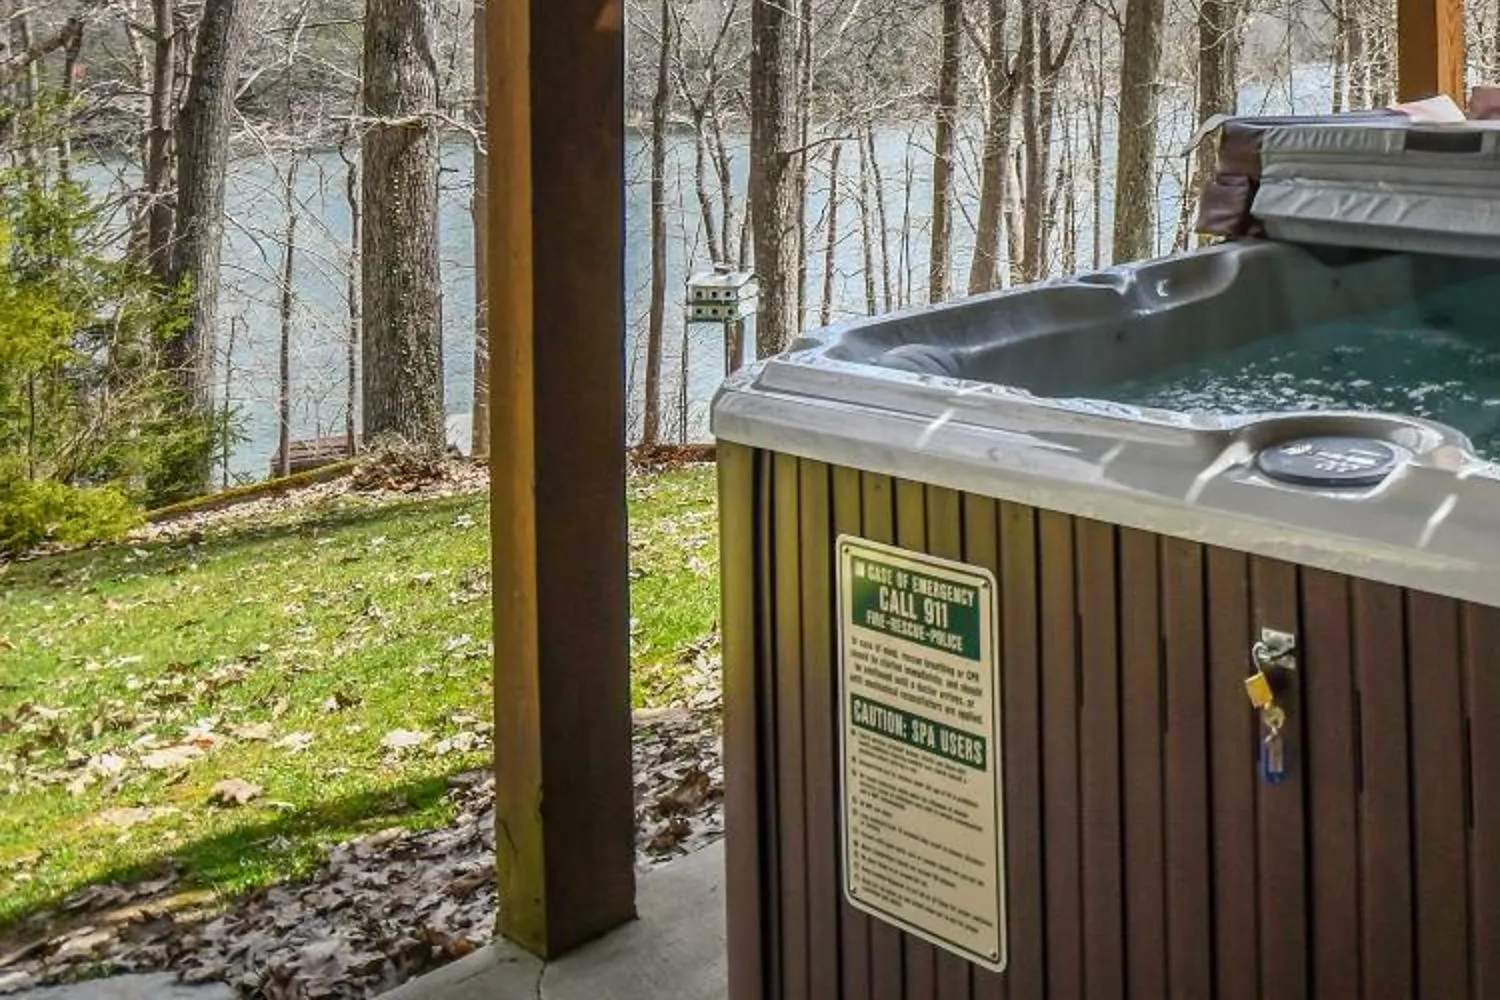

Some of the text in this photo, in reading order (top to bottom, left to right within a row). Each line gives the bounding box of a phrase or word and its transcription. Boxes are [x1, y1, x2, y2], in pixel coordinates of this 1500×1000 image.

[867, 564, 893, 586] CASE
[896, 572, 910, 589] OF
[912, 576, 976, 607] EMERGENCY
[879, 585, 949, 628] CALL 911
[853, 699, 908, 738] CAUTION:
[911, 719, 936, 749] SPA
[940, 730, 984, 765] USERS
